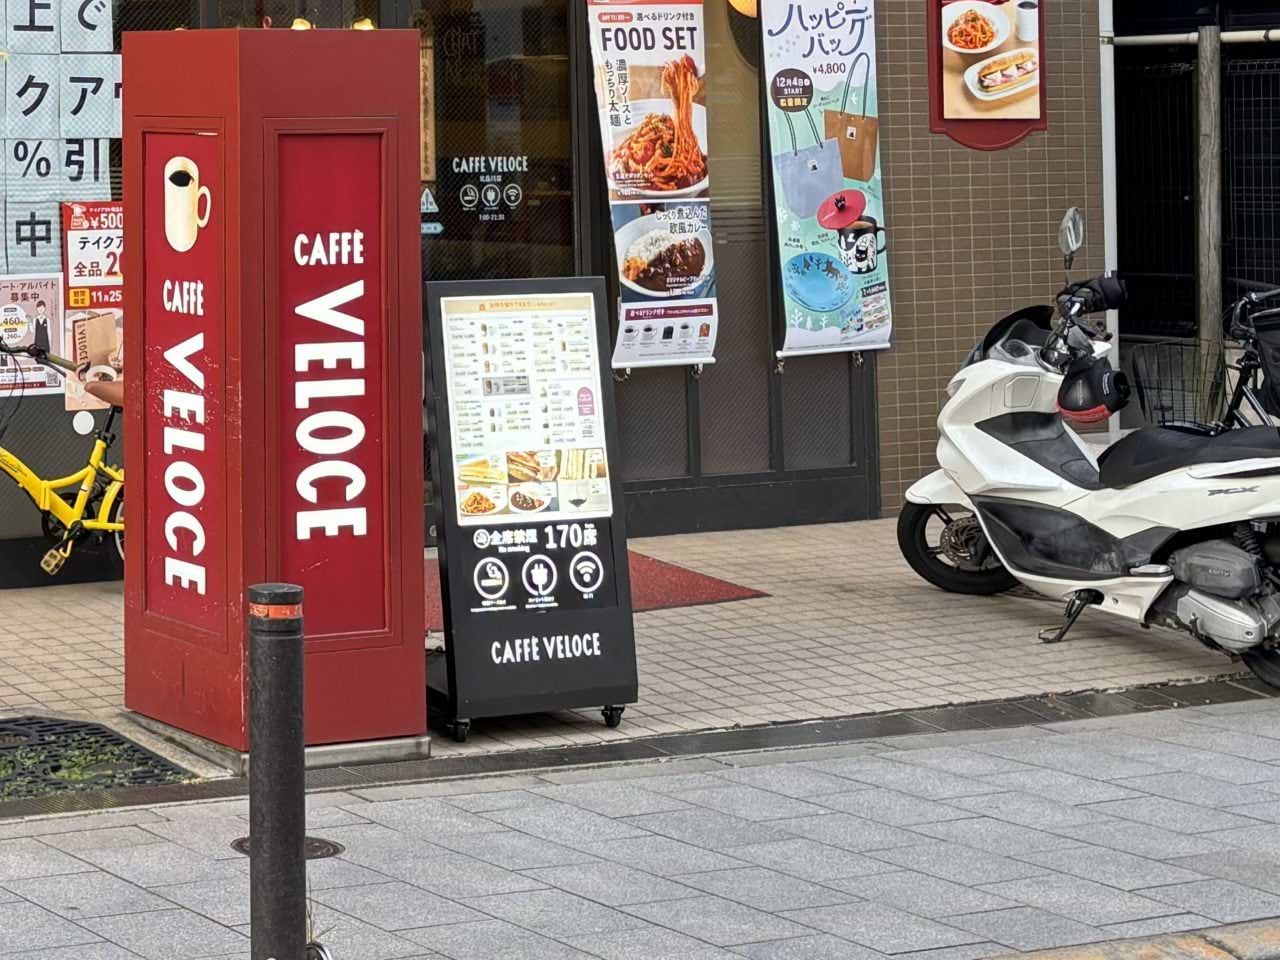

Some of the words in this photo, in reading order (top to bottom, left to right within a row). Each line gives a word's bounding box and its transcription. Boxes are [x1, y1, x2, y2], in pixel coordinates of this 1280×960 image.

[768, 2, 868, 37] ハッピー
[601, 27, 656, 51] FOOD
[661, 26, 698, 51] SET
[802, 15, 872, 58] バッグ
[488, 155, 529, 173] VELOCE
[669, 222, 708, 235] 欧風カレー
[294, 229, 365, 266] CAFFÈ
[74, 262, 102, 277] 全品
[10, 292, 40, 303] 募集中
[163, 279, 204, 316] CAFFÈ
[294, 279, 367, 540] VELOCE
[163, 332, 206, 596] VELOCE
[542, 632, 602, 659] VELOCE
